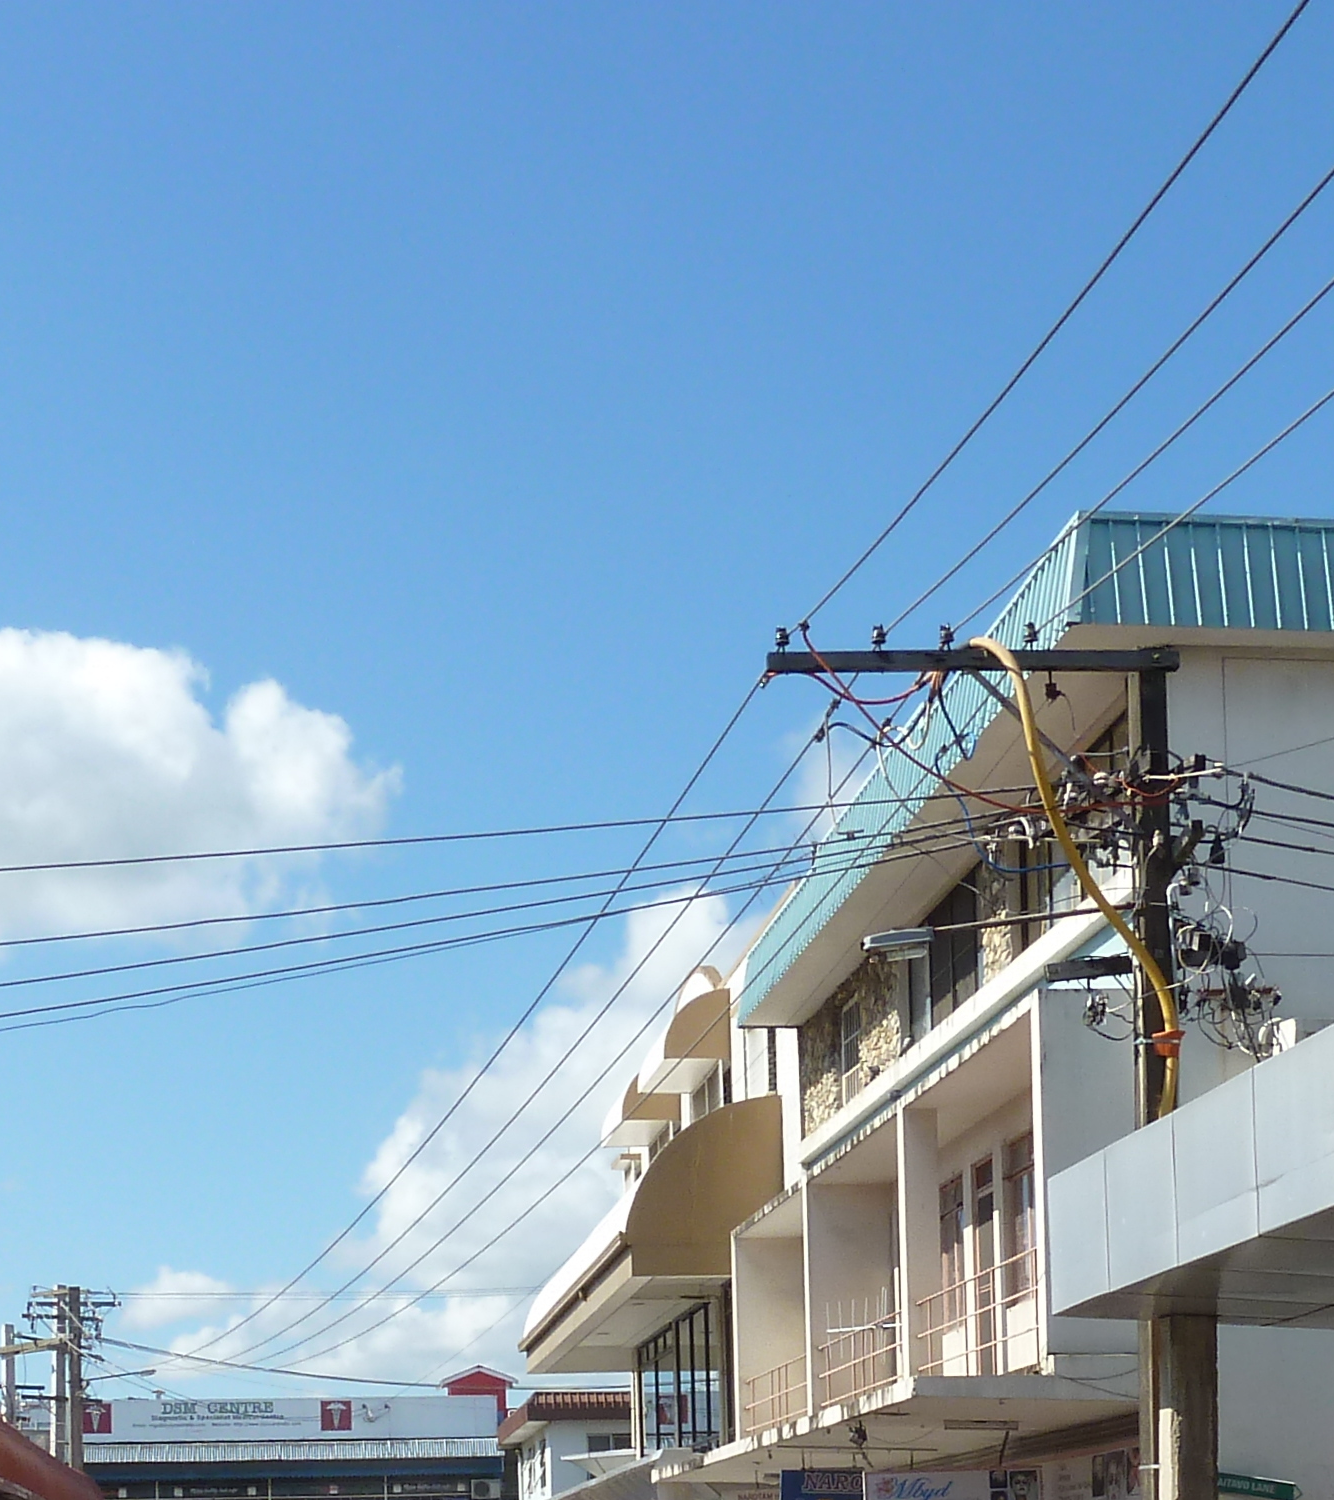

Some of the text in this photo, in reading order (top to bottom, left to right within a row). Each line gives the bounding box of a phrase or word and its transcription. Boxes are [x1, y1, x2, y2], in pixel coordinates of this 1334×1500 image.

[161, 1401, 275, 1415] DSM CENTRE
[801, 1471, 864, 1493] NARO
